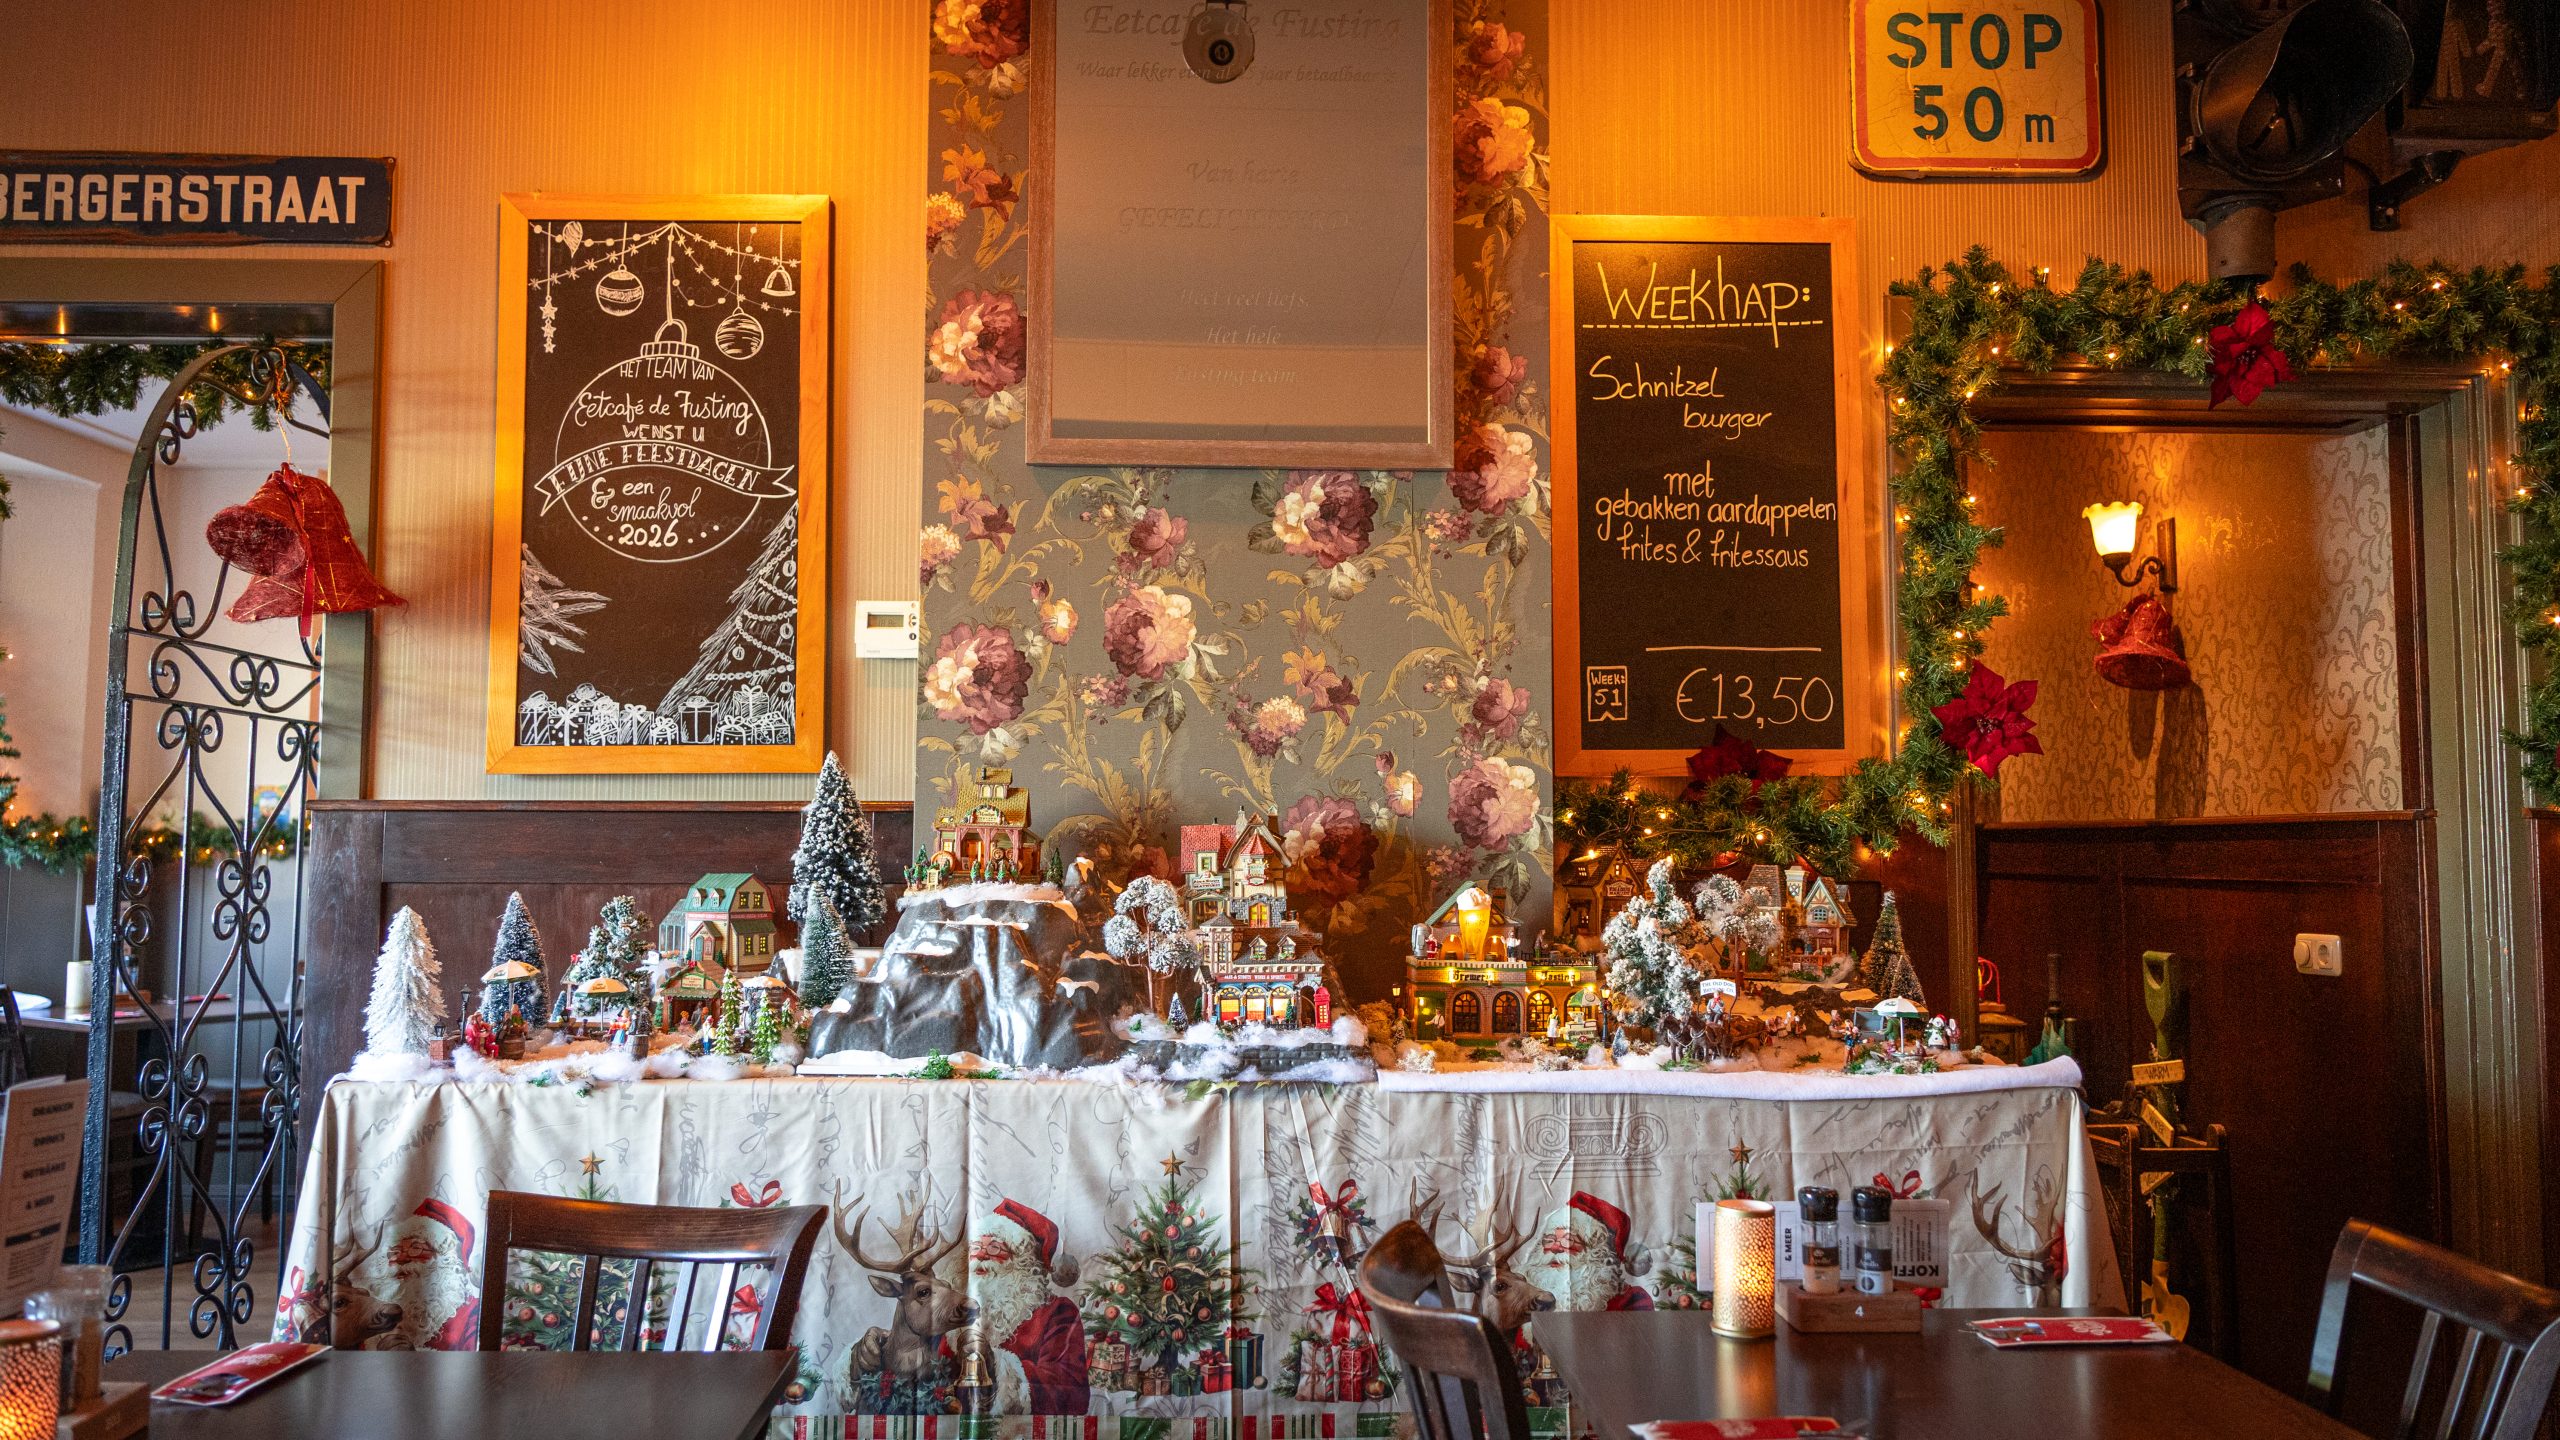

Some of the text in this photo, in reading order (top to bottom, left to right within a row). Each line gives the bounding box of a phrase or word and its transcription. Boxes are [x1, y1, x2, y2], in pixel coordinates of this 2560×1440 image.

[1887, 12, 2063, 70] STOP
[1912, 85, 2055, 143] 50 m
[1207, 324, 1282, 345] Het hele
[620, 356, 715, 381] HET TEAM VAN
[1588, 354, 1725, 401] Schnitzel
[649, 394, 671, 416] de
[674, 390, 754, 436] Fusting
[1683, 402, 1773, 440] burger
[622, 424, 685, 442] WENST
[620, 443, 762, 492] FEESTDAGEN
[1663, 459, 1715, 499] met
[606, 486, 702, 522] smaakvol
[622, 481, 654, 496] een
[1595, 487, 1837, 541] gebakken aardappelen
[618, 518, 679, 548] 2026
[1616, 521, 1677, 563] frites
[1709, 529, 1809, 568] fritessaus
[1594, 688, 1623, 707] 51
[1675, 667, 1834, 729] €13,50
[1784, 1227, 1793, 1248] MEER
[1893, 1265, 1939, 1277] KOFFI
[1854, 1305, 1864, 1317] 4
